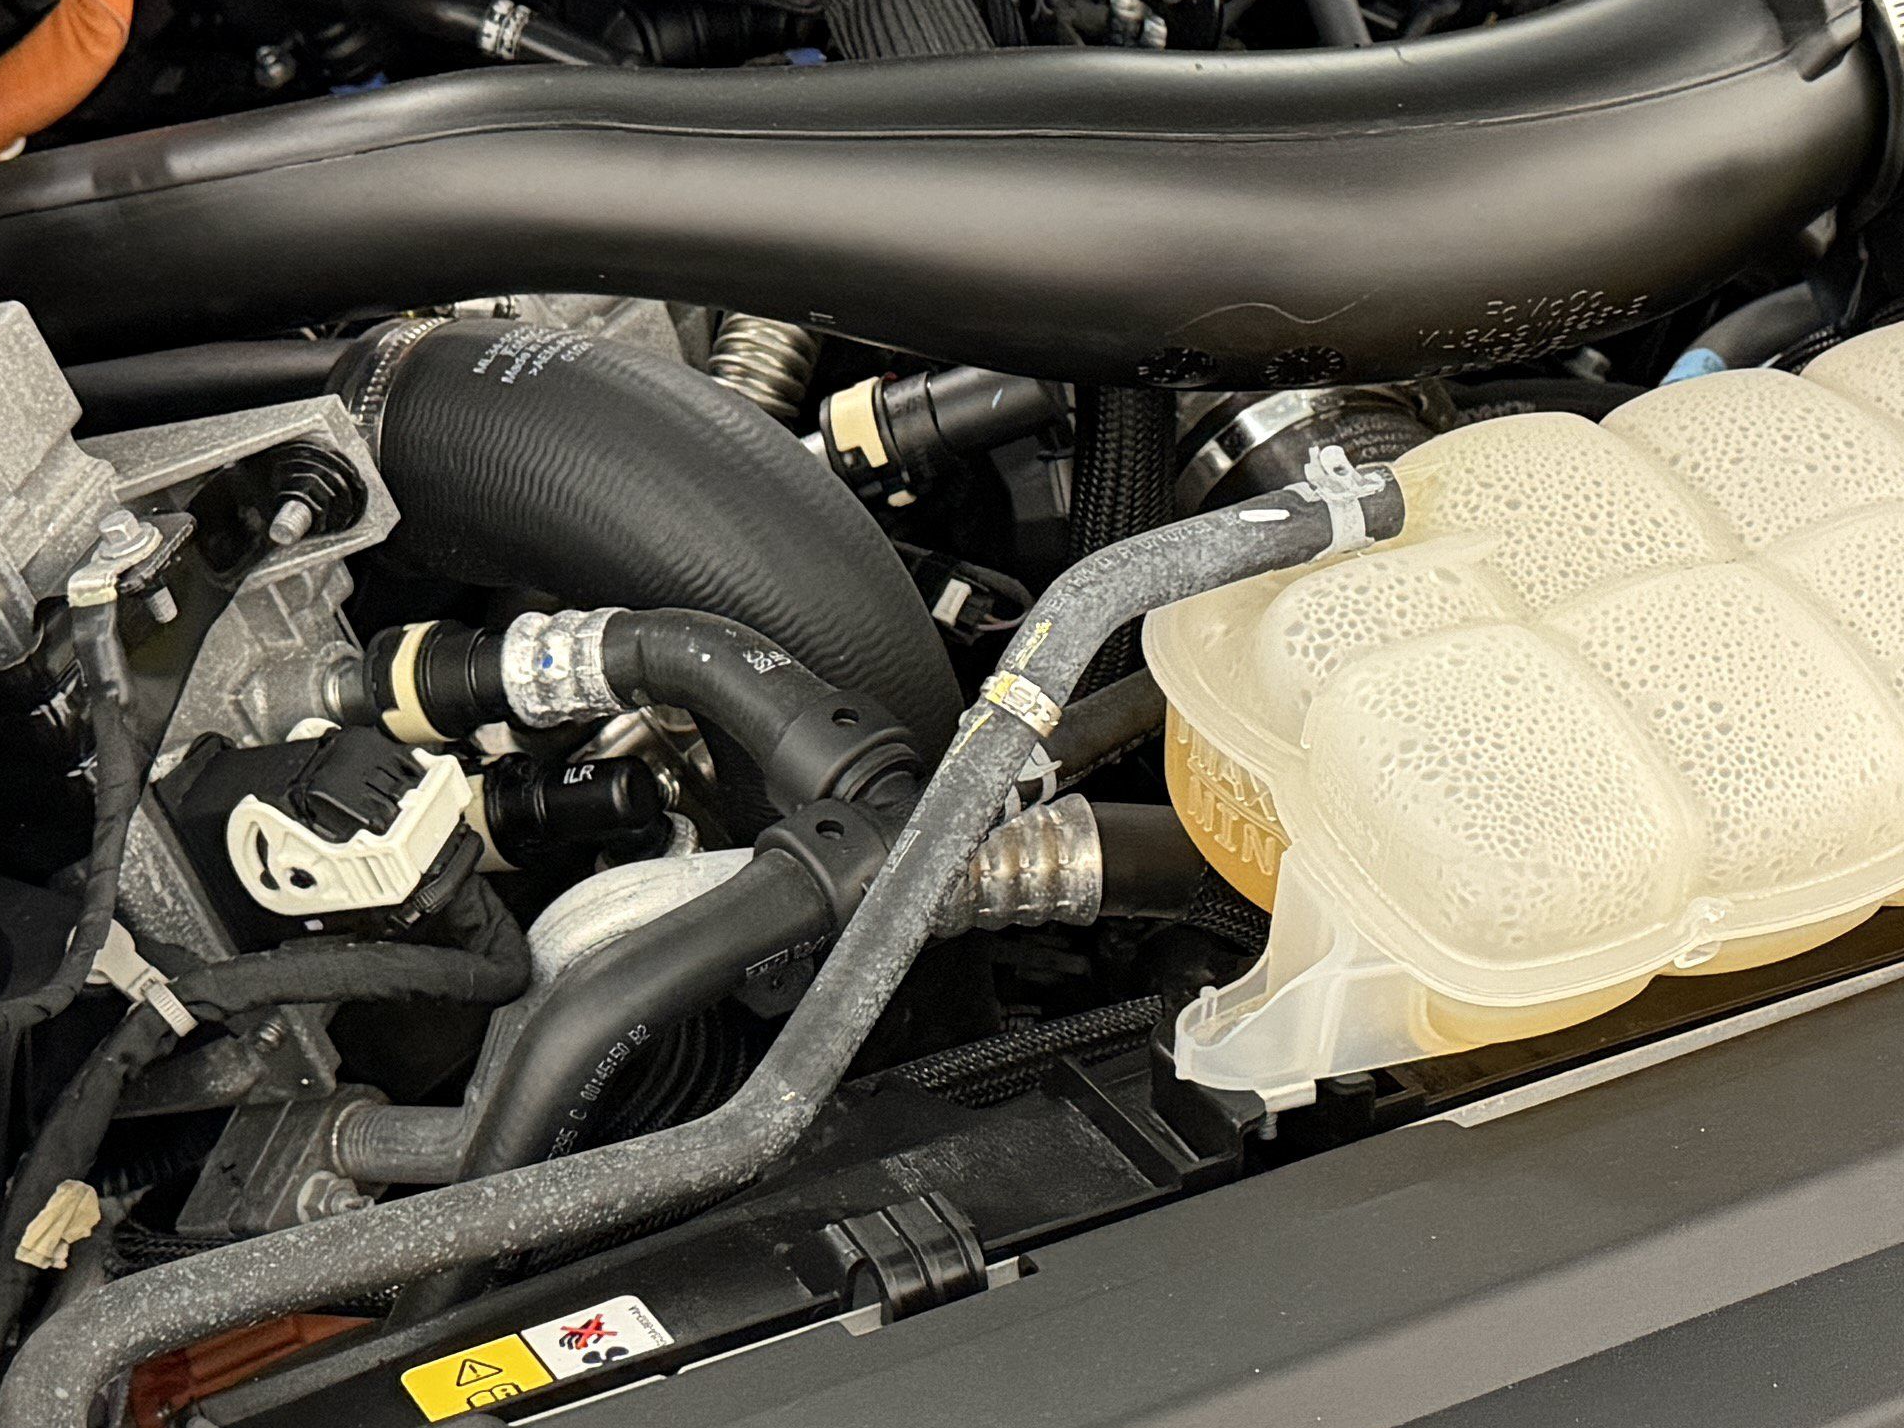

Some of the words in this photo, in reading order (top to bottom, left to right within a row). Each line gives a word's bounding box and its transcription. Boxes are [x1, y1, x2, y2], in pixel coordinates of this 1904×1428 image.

[563, 763, 595, 785] ILR
[1186, 774, 1278, 877] MIN
[568, 1108, 586, 1119] C
[627, 1024, 649, 1044] B2
